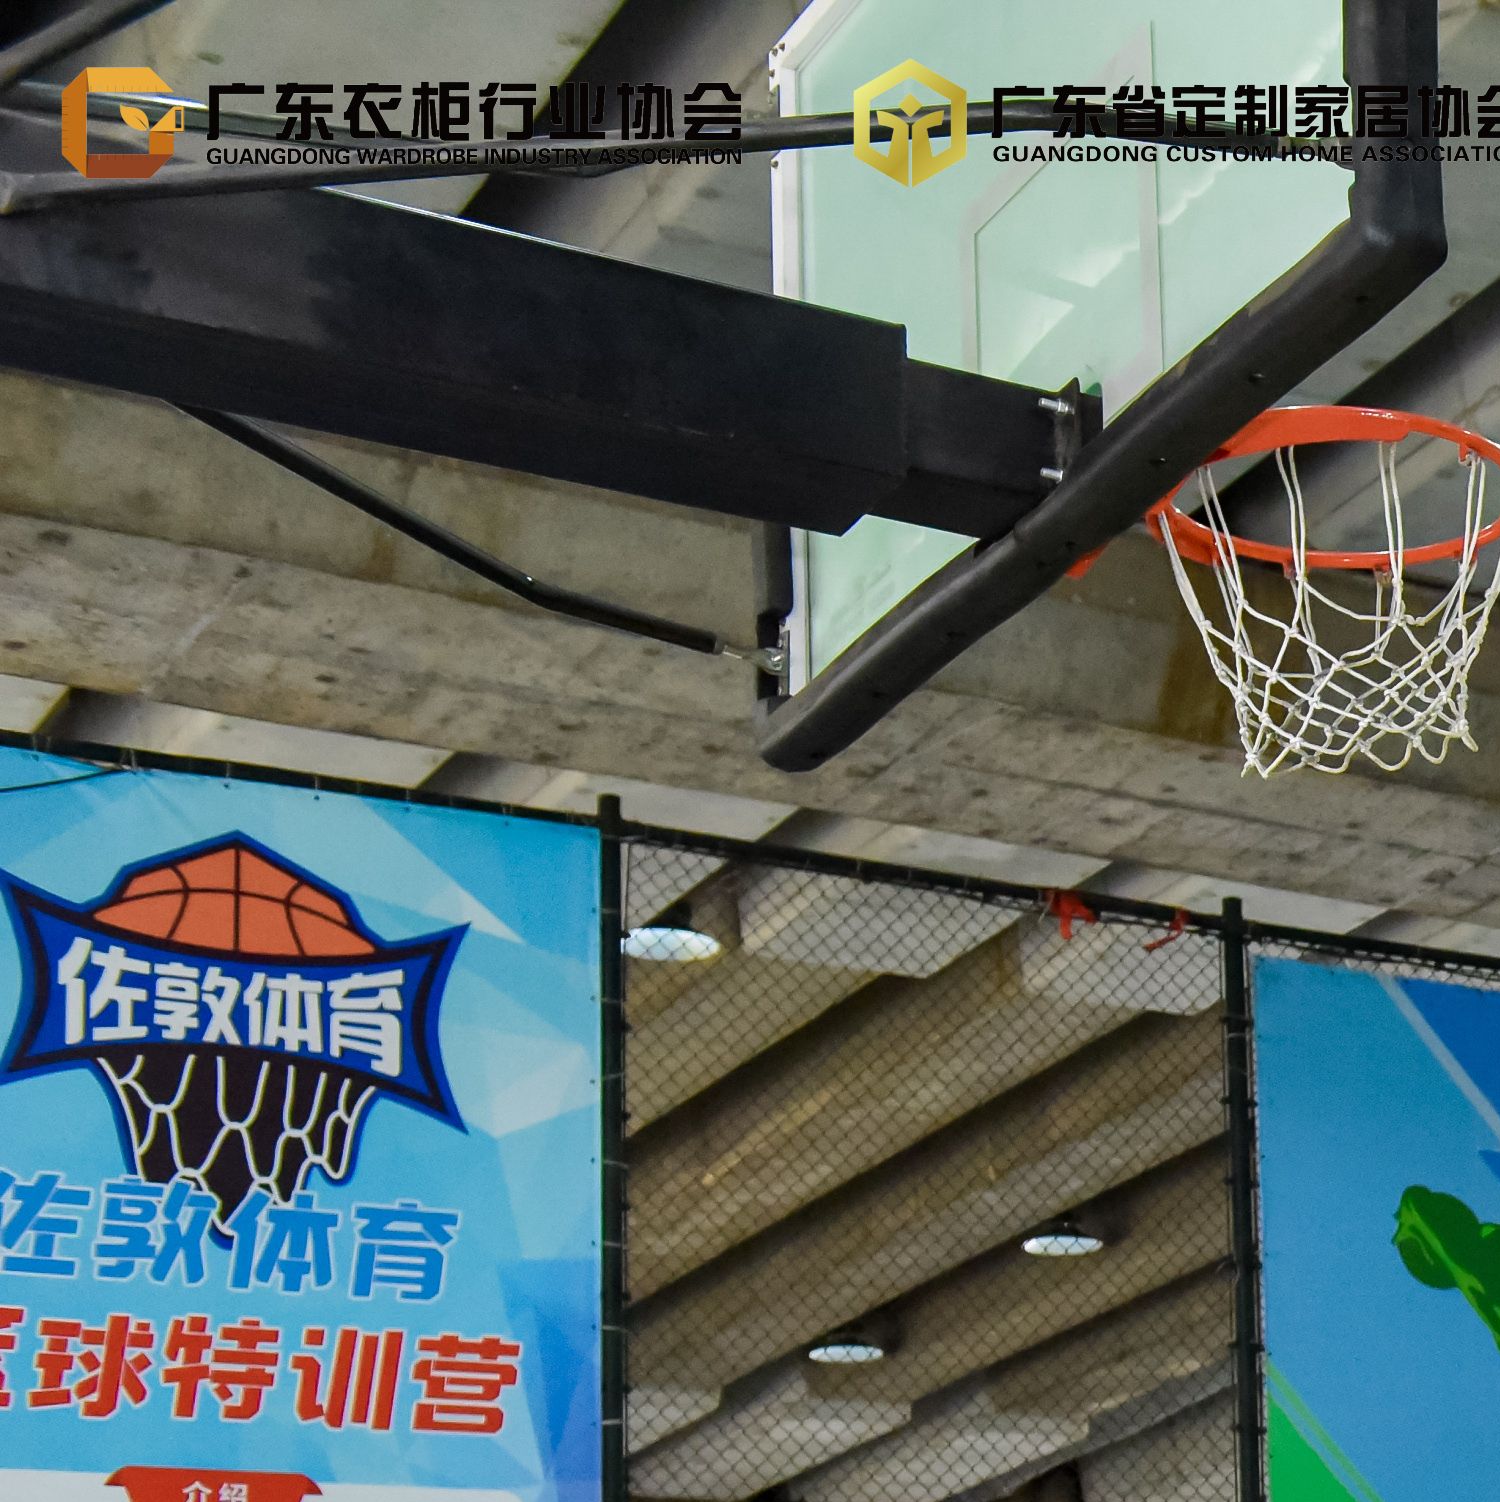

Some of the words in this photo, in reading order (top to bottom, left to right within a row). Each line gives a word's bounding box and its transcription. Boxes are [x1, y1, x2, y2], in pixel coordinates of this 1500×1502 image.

[57, 935, 406, 1078] 佐敦体育
[0, 1170, 463, 1302] 佐敦体育
